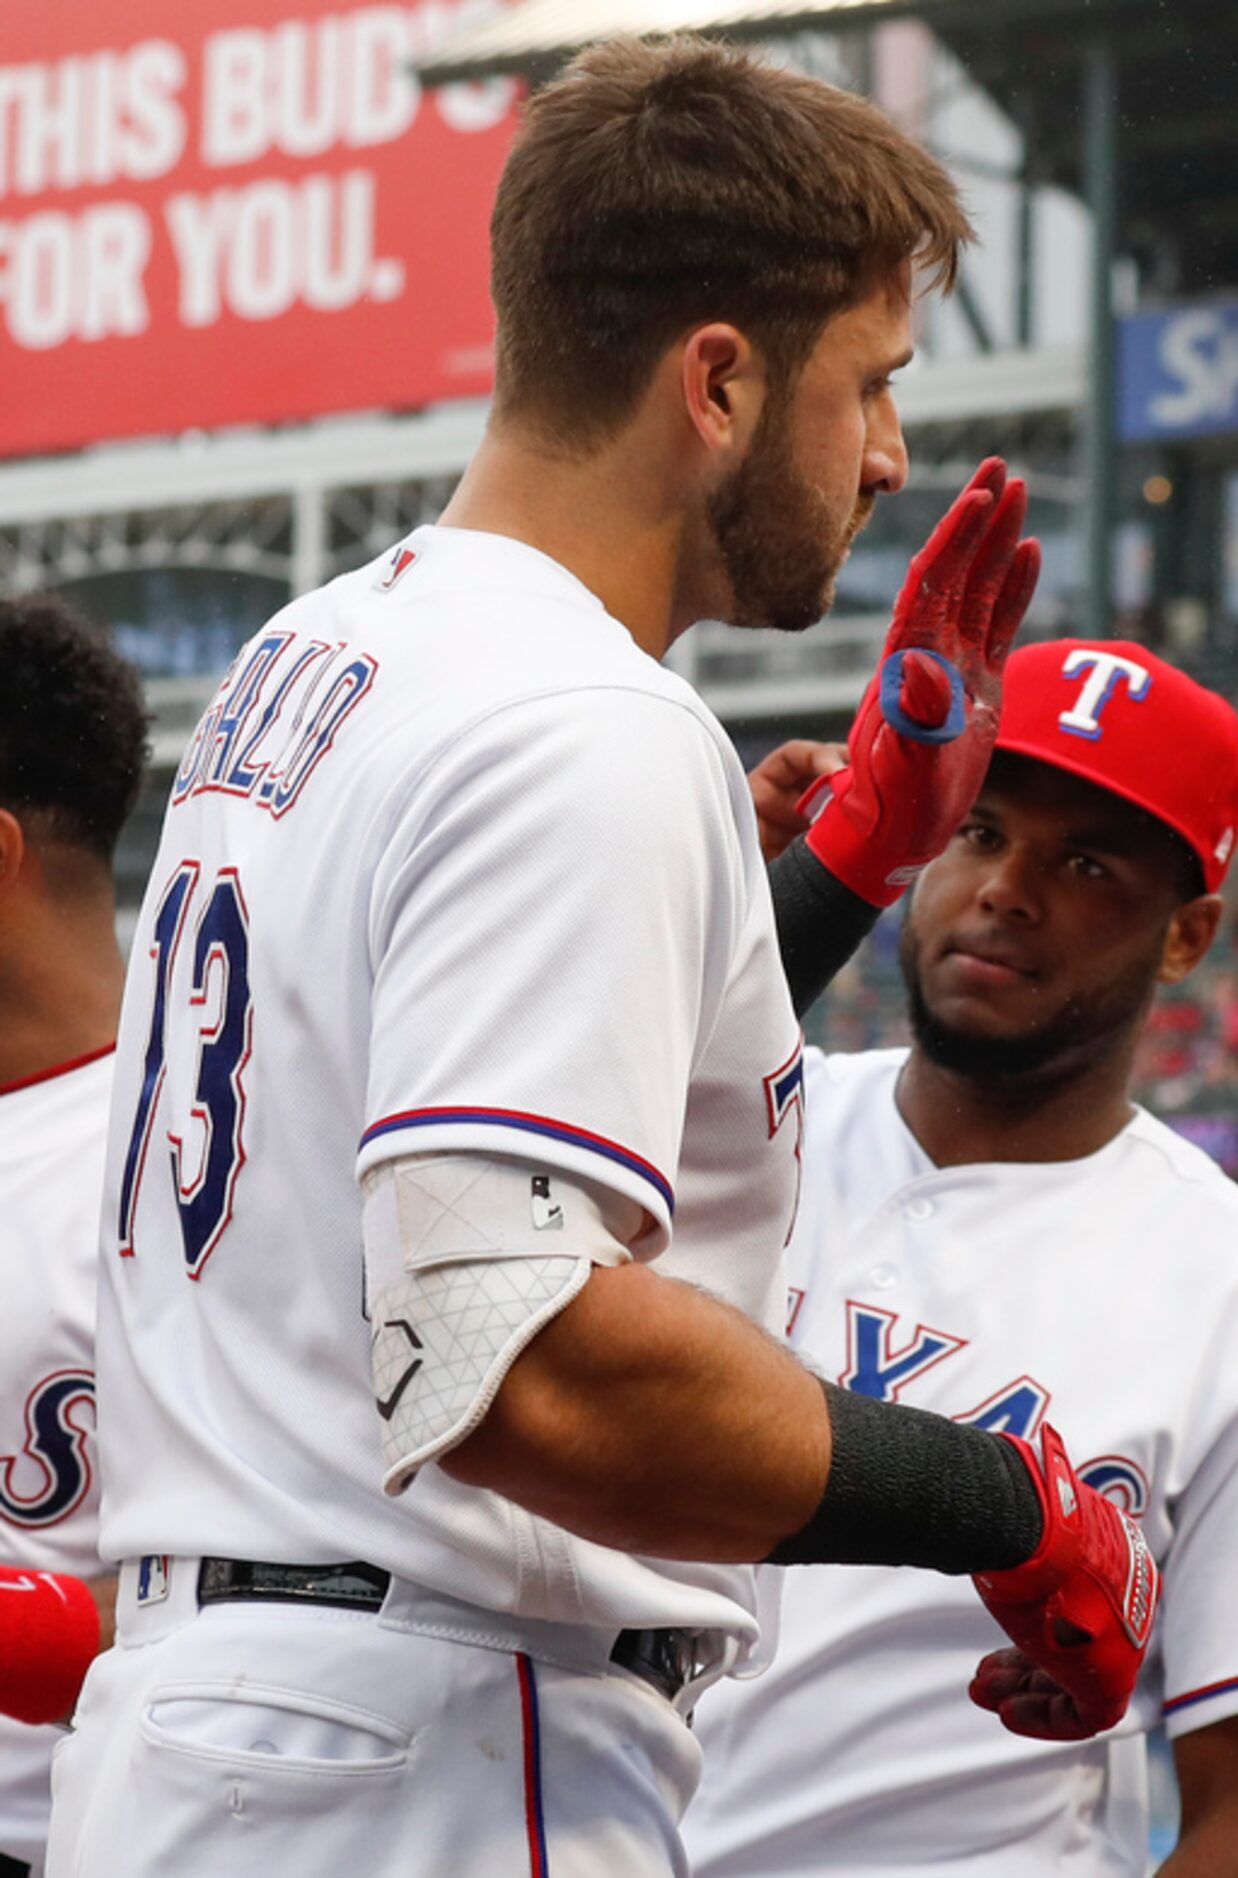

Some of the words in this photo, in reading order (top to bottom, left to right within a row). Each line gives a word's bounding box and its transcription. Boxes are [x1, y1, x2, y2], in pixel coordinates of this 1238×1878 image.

[163, 170, 405, 330] YOU.
[1058, 649, 1152, 741] T
[118, 858, 255, 1281] 13
